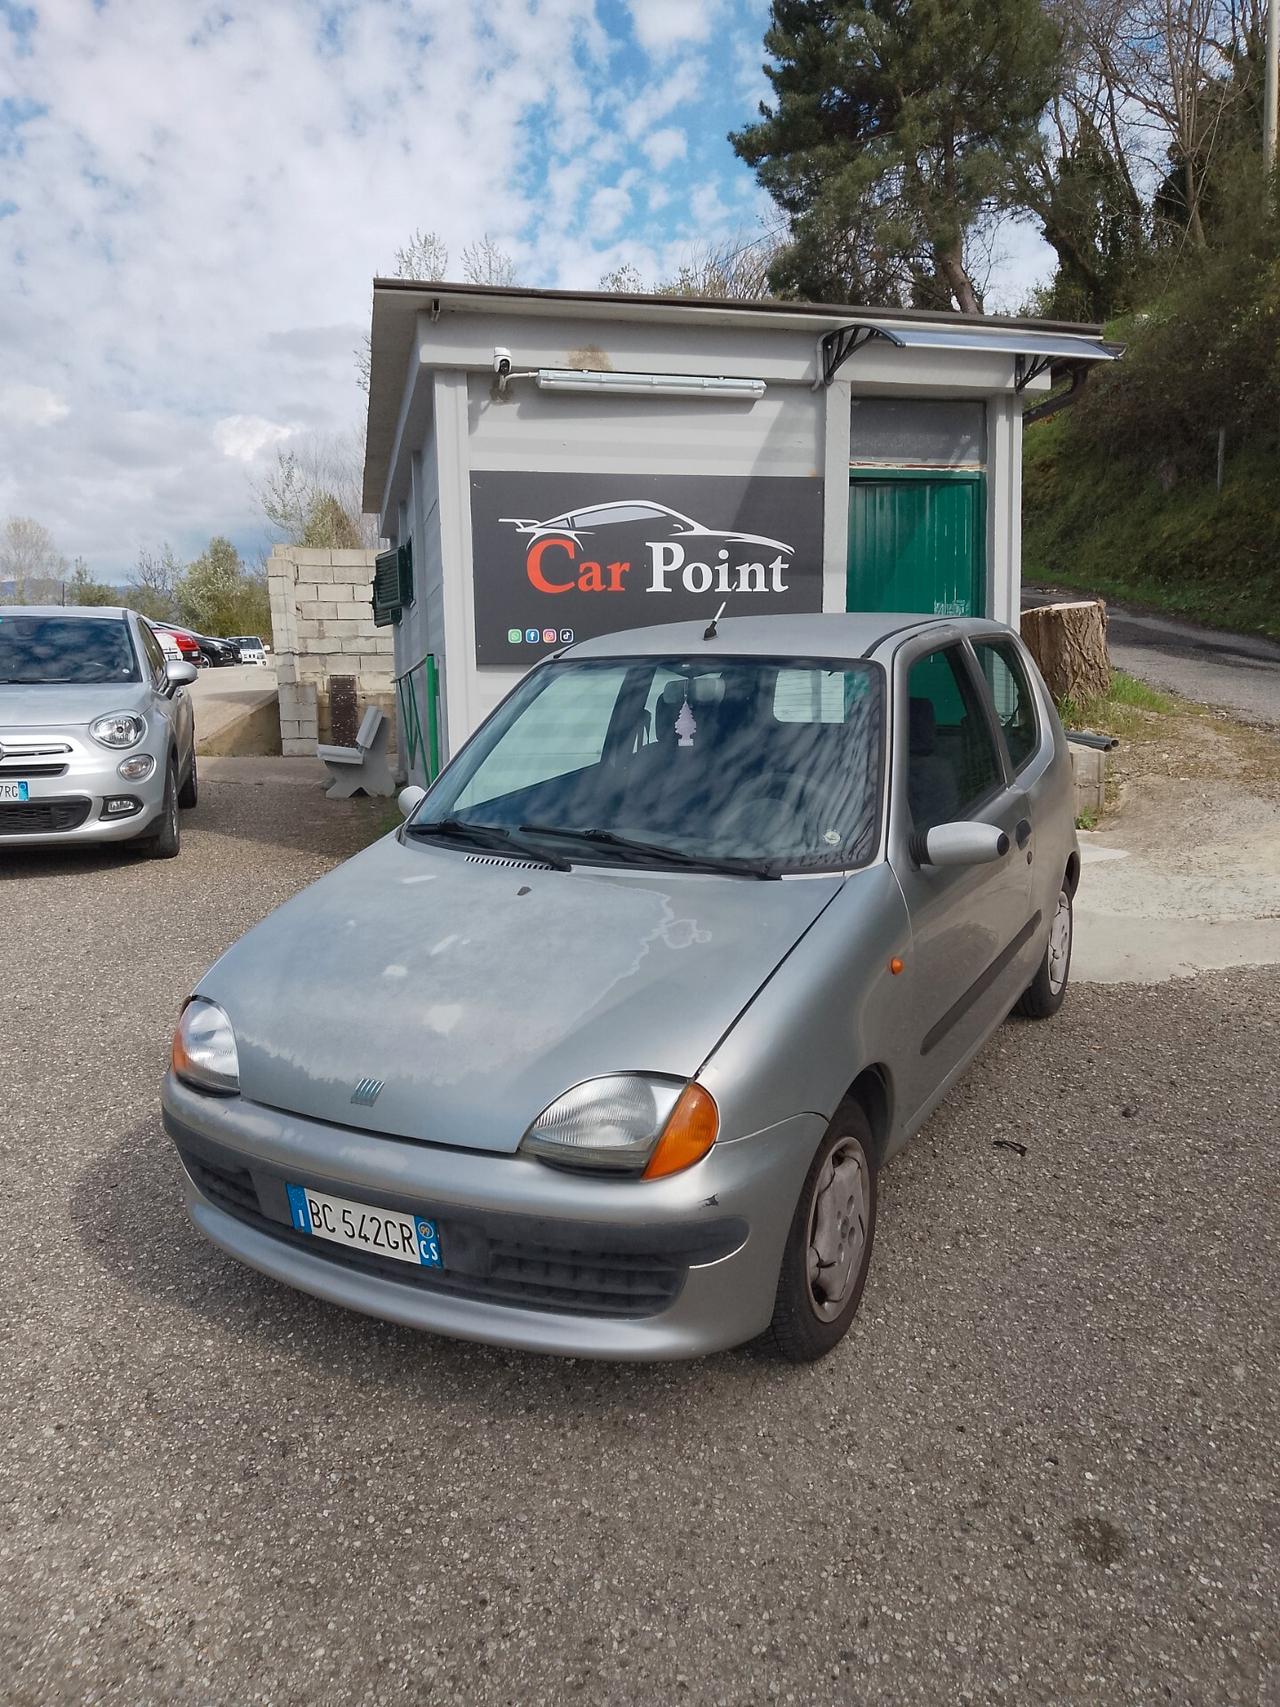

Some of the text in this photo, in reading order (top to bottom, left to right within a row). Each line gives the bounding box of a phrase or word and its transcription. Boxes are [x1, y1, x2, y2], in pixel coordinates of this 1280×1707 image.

[526, 538, 790, 594] Car Point
[308, 1198, 417, 1256] BC 542GR
[419, 1240, 439, 1261] CS
